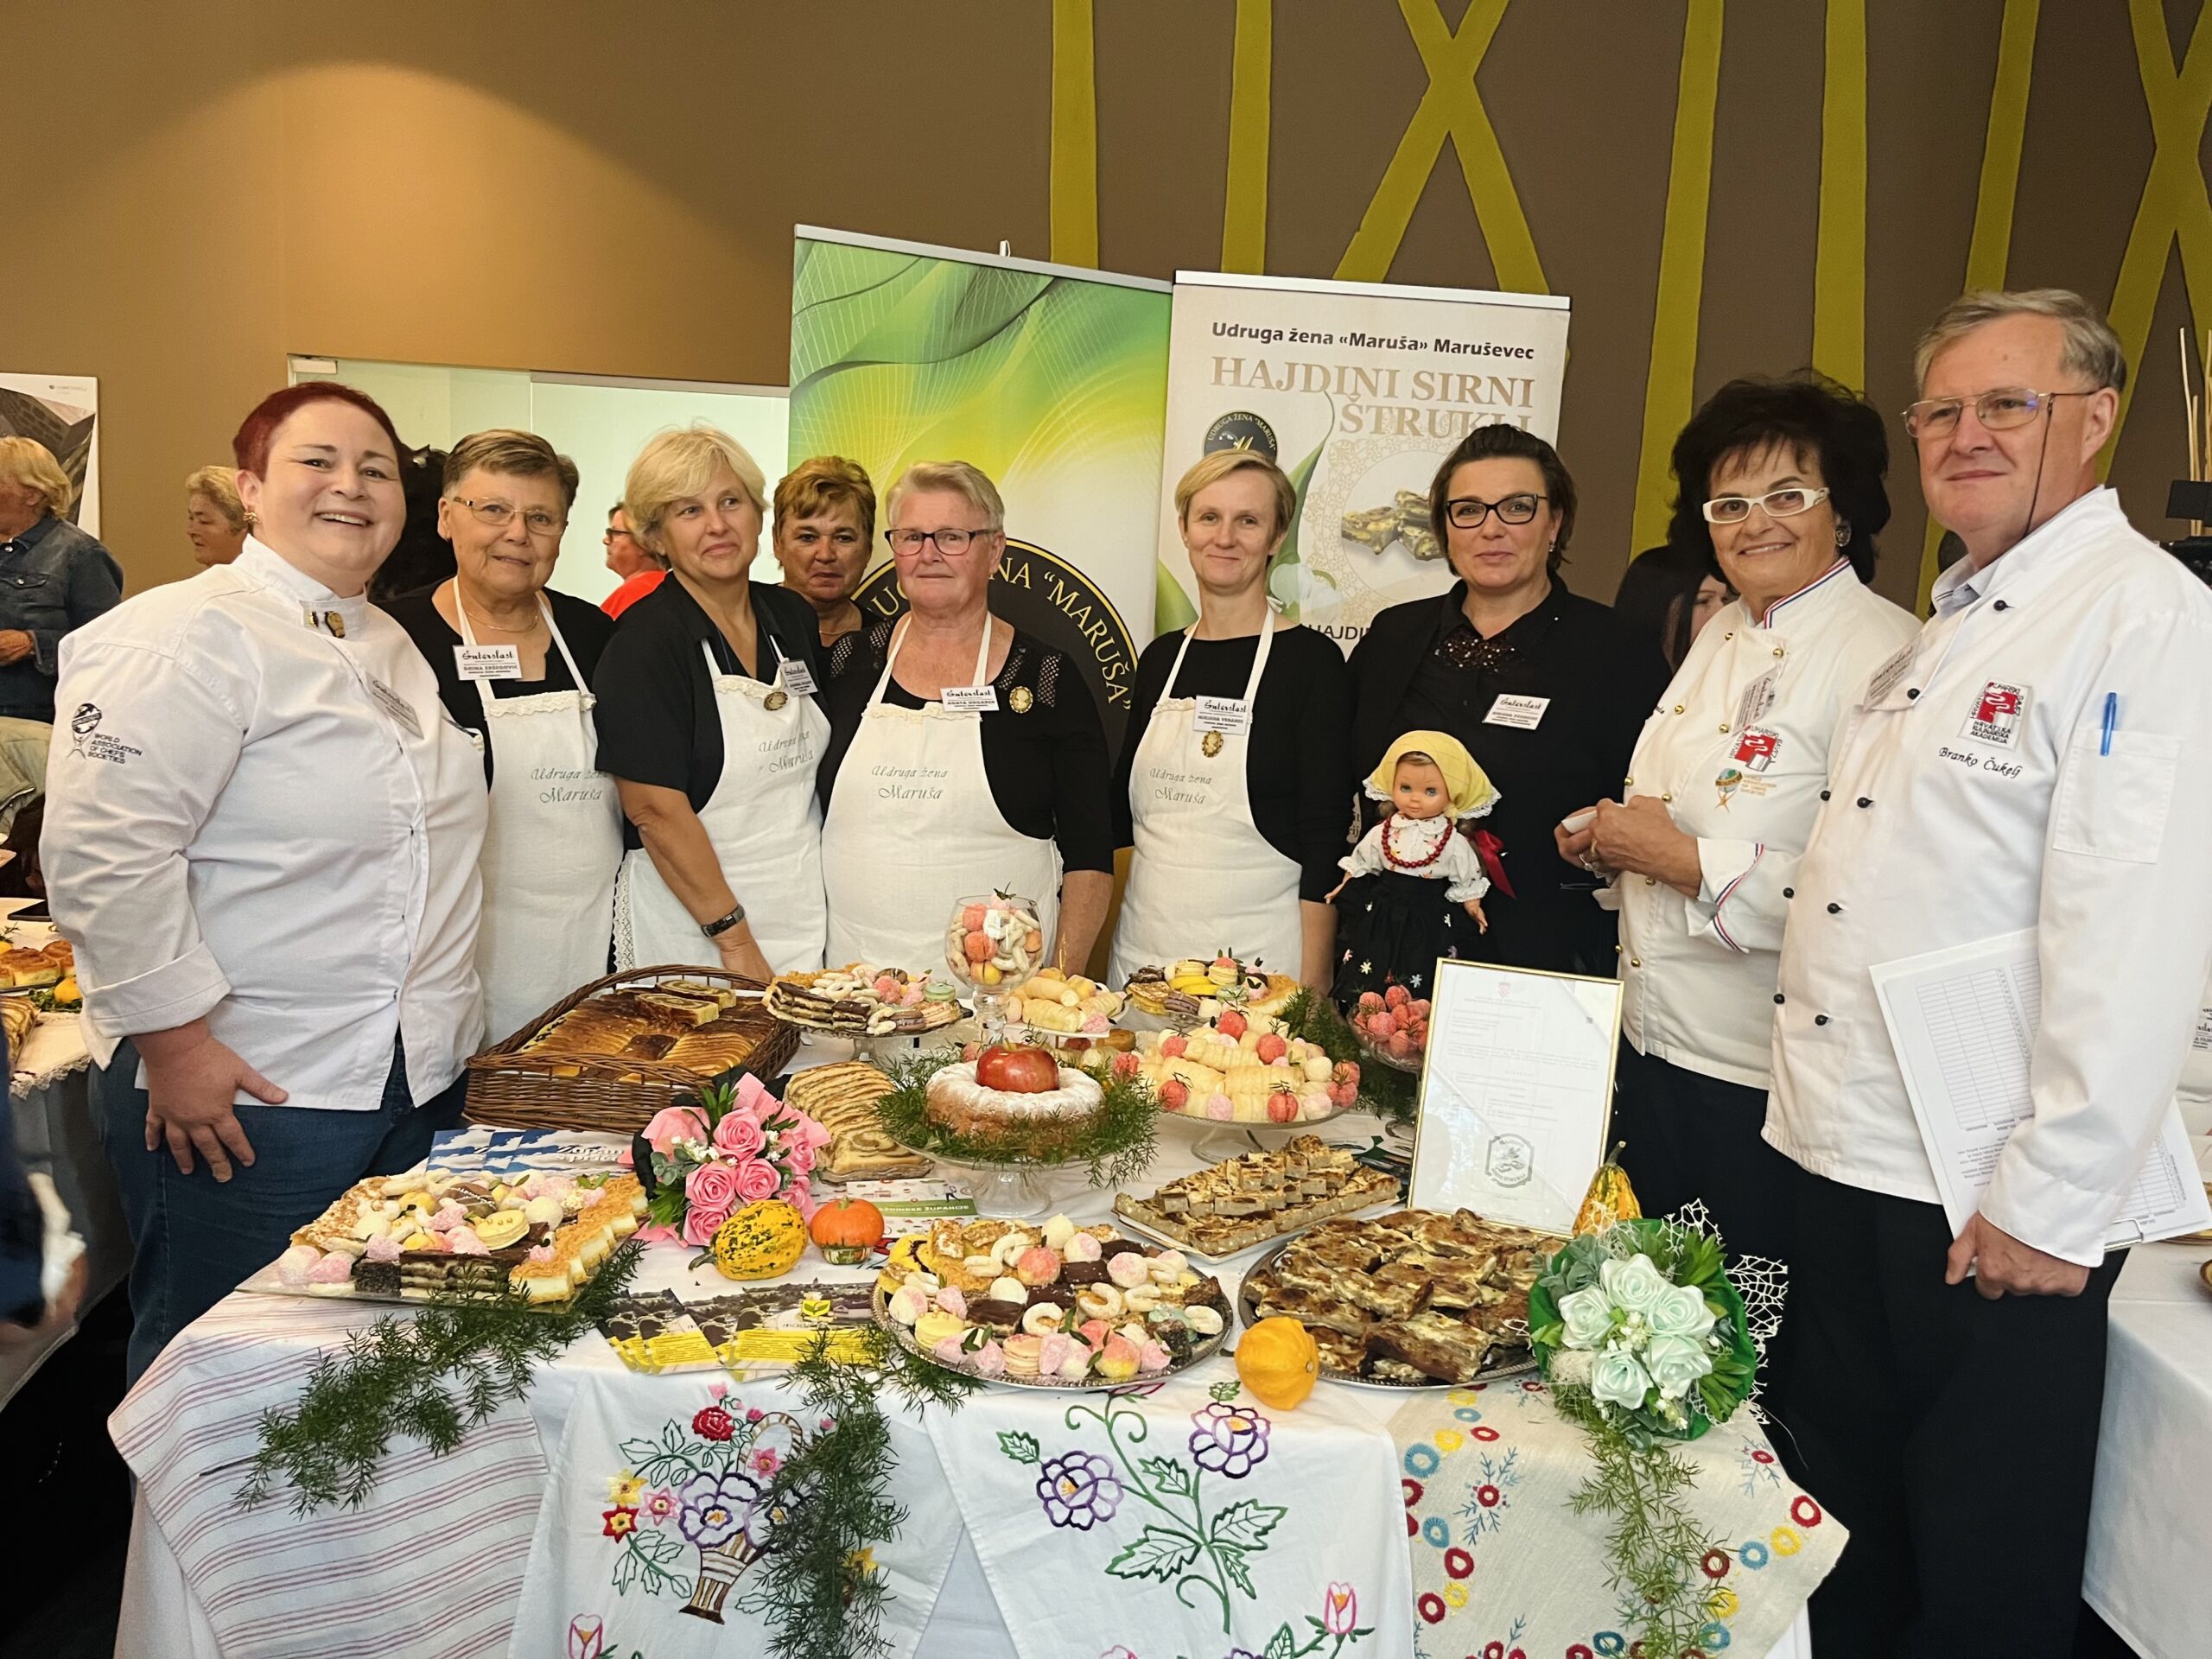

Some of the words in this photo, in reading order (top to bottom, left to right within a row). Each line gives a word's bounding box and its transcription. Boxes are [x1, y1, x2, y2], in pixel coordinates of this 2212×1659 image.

[1212, 322, 1283, 344] Udruga
[1288, 328, 1333, 345] žena
[1339, 333, 1427, 351] «Maruša»
[1433, 339, 1535, 359] Maruševec
[1210, 355, 1401, 398] HAJDINI
[1411, 370, 1535, 408] SIRNI
[1207, 416, 1233, 441] UDRUGA
[1938, 747, 1979, 767] Branko
[531, 767, 582, 781] Udruga
[871, 766, 917, 780] Udruga
[920, 766, 949, 779] žena
[1149, 768, 1185, 784] Udruga
[539, 787, 603, 804] Maruša
[878, 784, 944, 800] Maruša
[1154, 786, 1207, 804] Maruša
